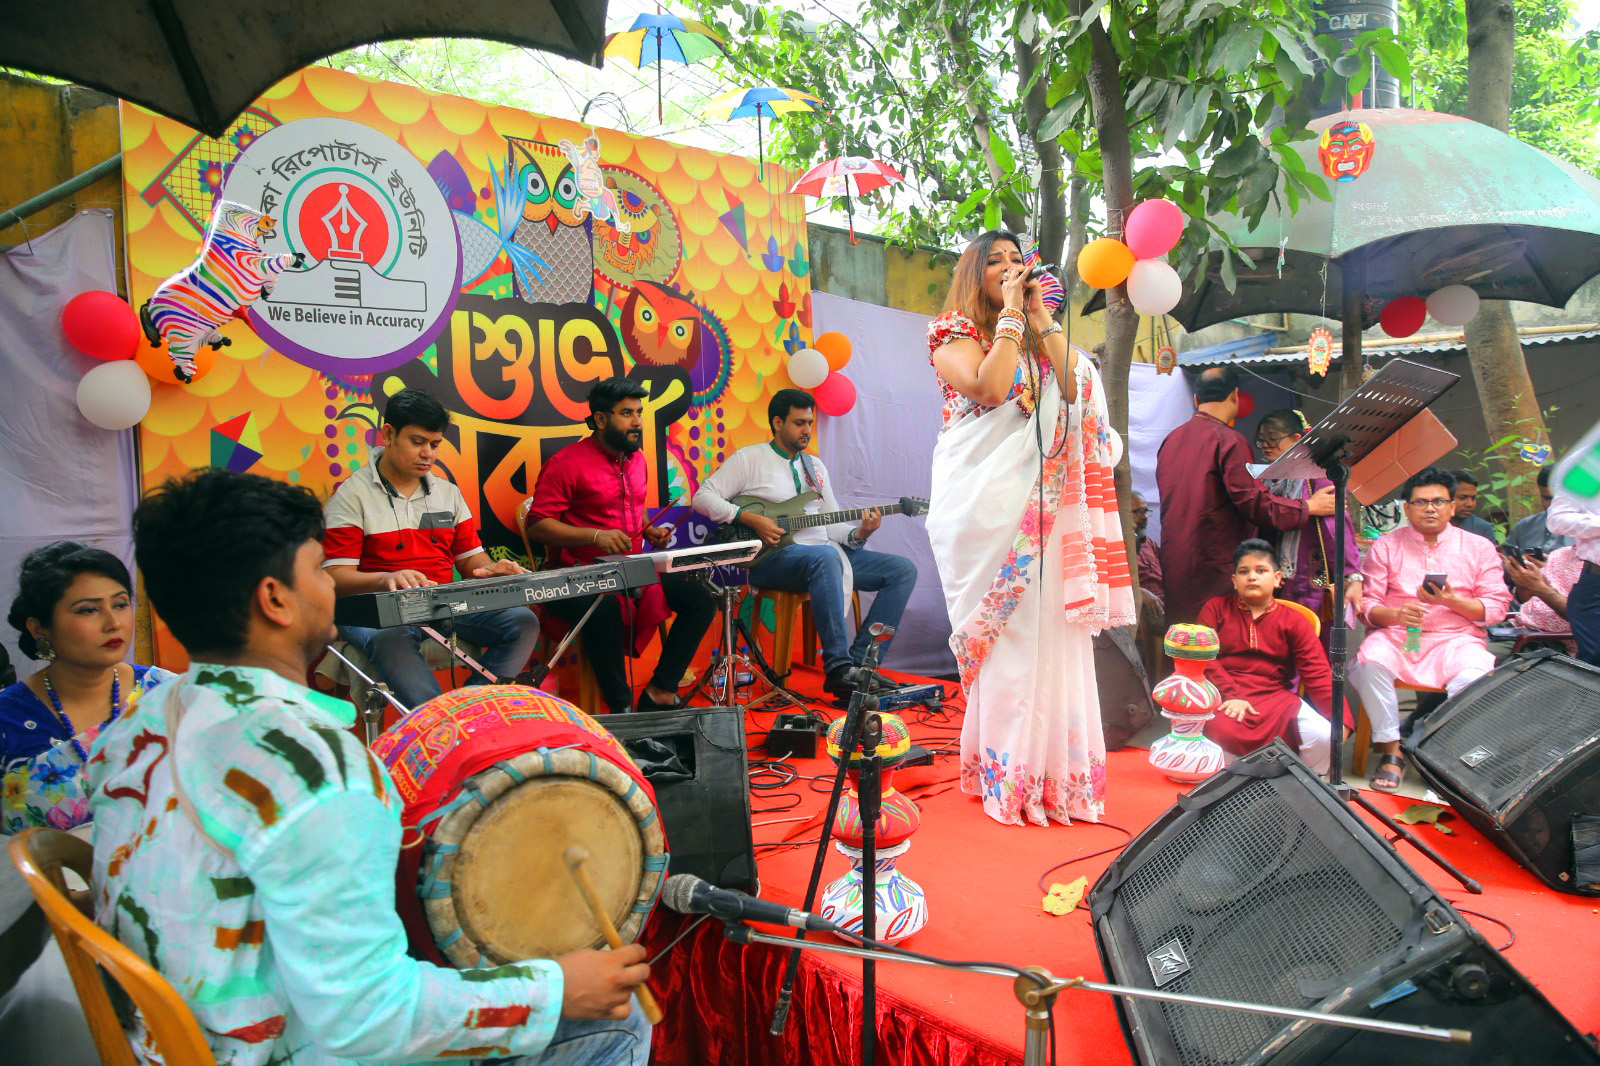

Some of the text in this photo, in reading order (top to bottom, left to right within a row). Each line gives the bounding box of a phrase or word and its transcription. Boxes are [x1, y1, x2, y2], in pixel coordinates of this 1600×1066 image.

[1329, 13, 1367, 30] GAZI
[271, 139, 388, 182] রিপোর্টার্স
[387, 168, 428, 260] ইউনিটি
[267, 305, 425, 332] We Believe in Accuracy
[524, 578, 617, 602] Roland XP-60
